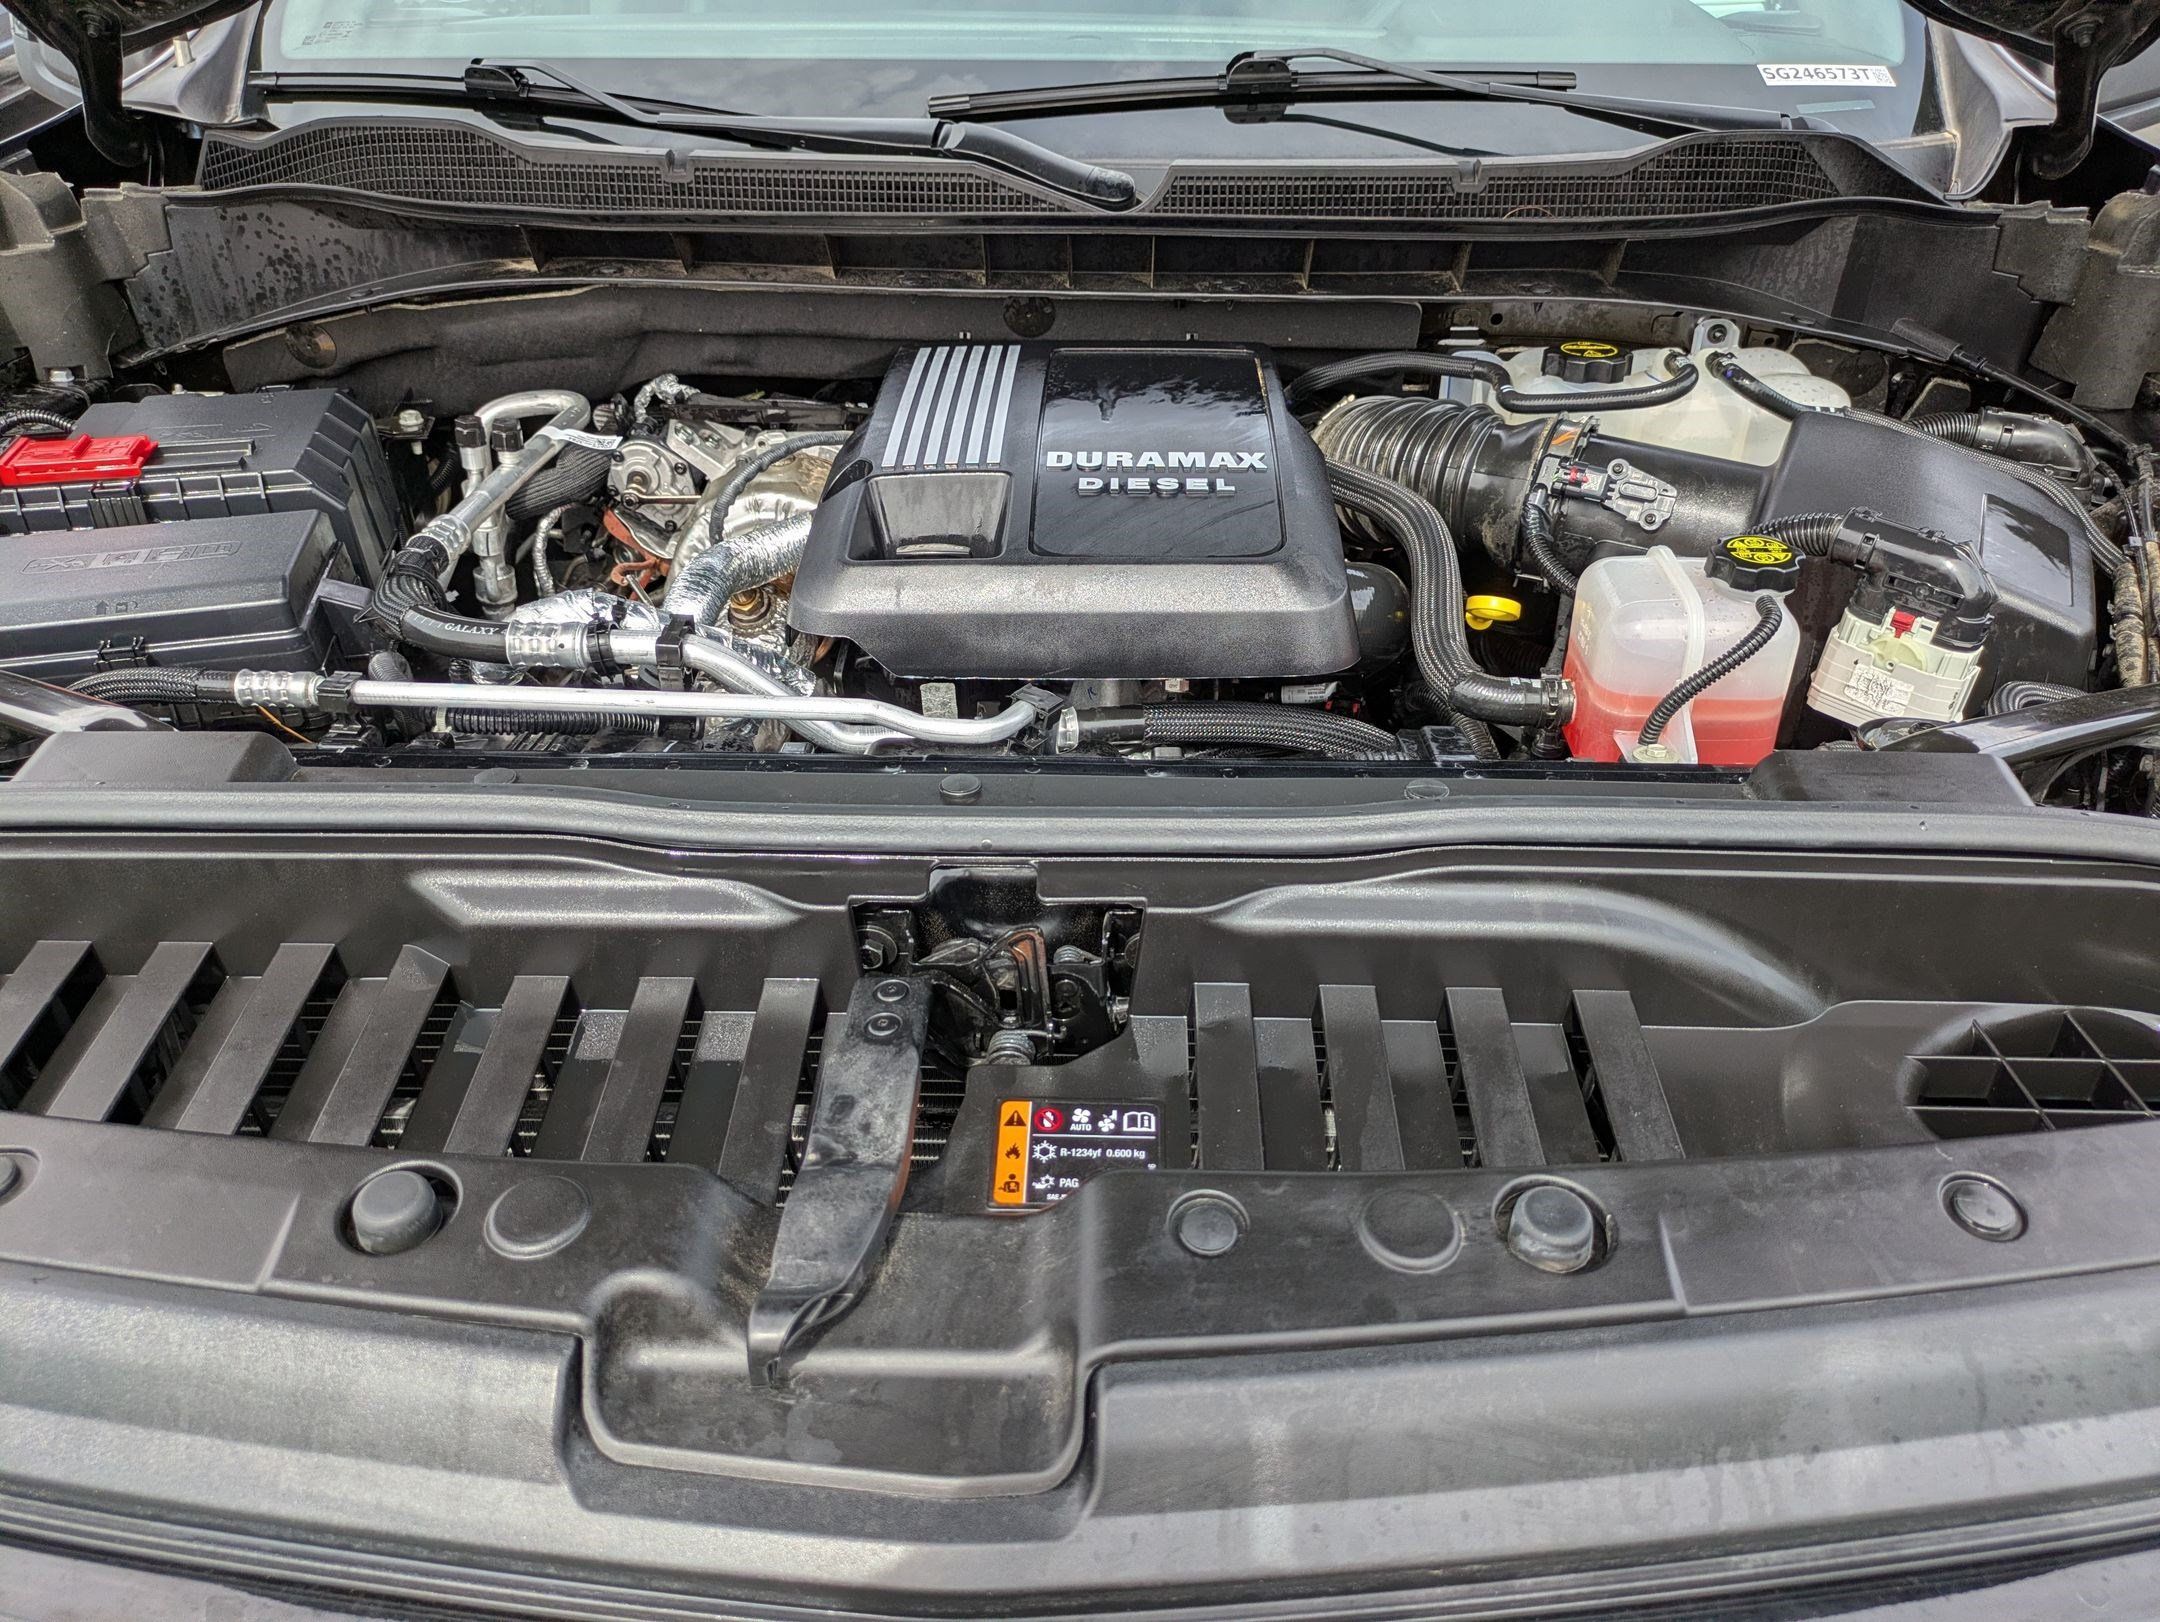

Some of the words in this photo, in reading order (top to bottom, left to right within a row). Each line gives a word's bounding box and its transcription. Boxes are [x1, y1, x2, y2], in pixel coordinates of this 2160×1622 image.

[1762, 67, 1870, 80] SG246573T
[1046, 451, 1268, 472] DURAMAX
[1077, 477, 1236, 496] DIESEL
[444, 623, 499, 636] GALAXY
[1070, 1123, 1092, 1131] AUTO
[1060, 1148, 1102, 1159] R-1234yf
[1106, 1148, 1132, 1158] 0.600
[1133, 1149, 1146, 1159] kg
[1059, 1178, 1079, 1188] PAG
